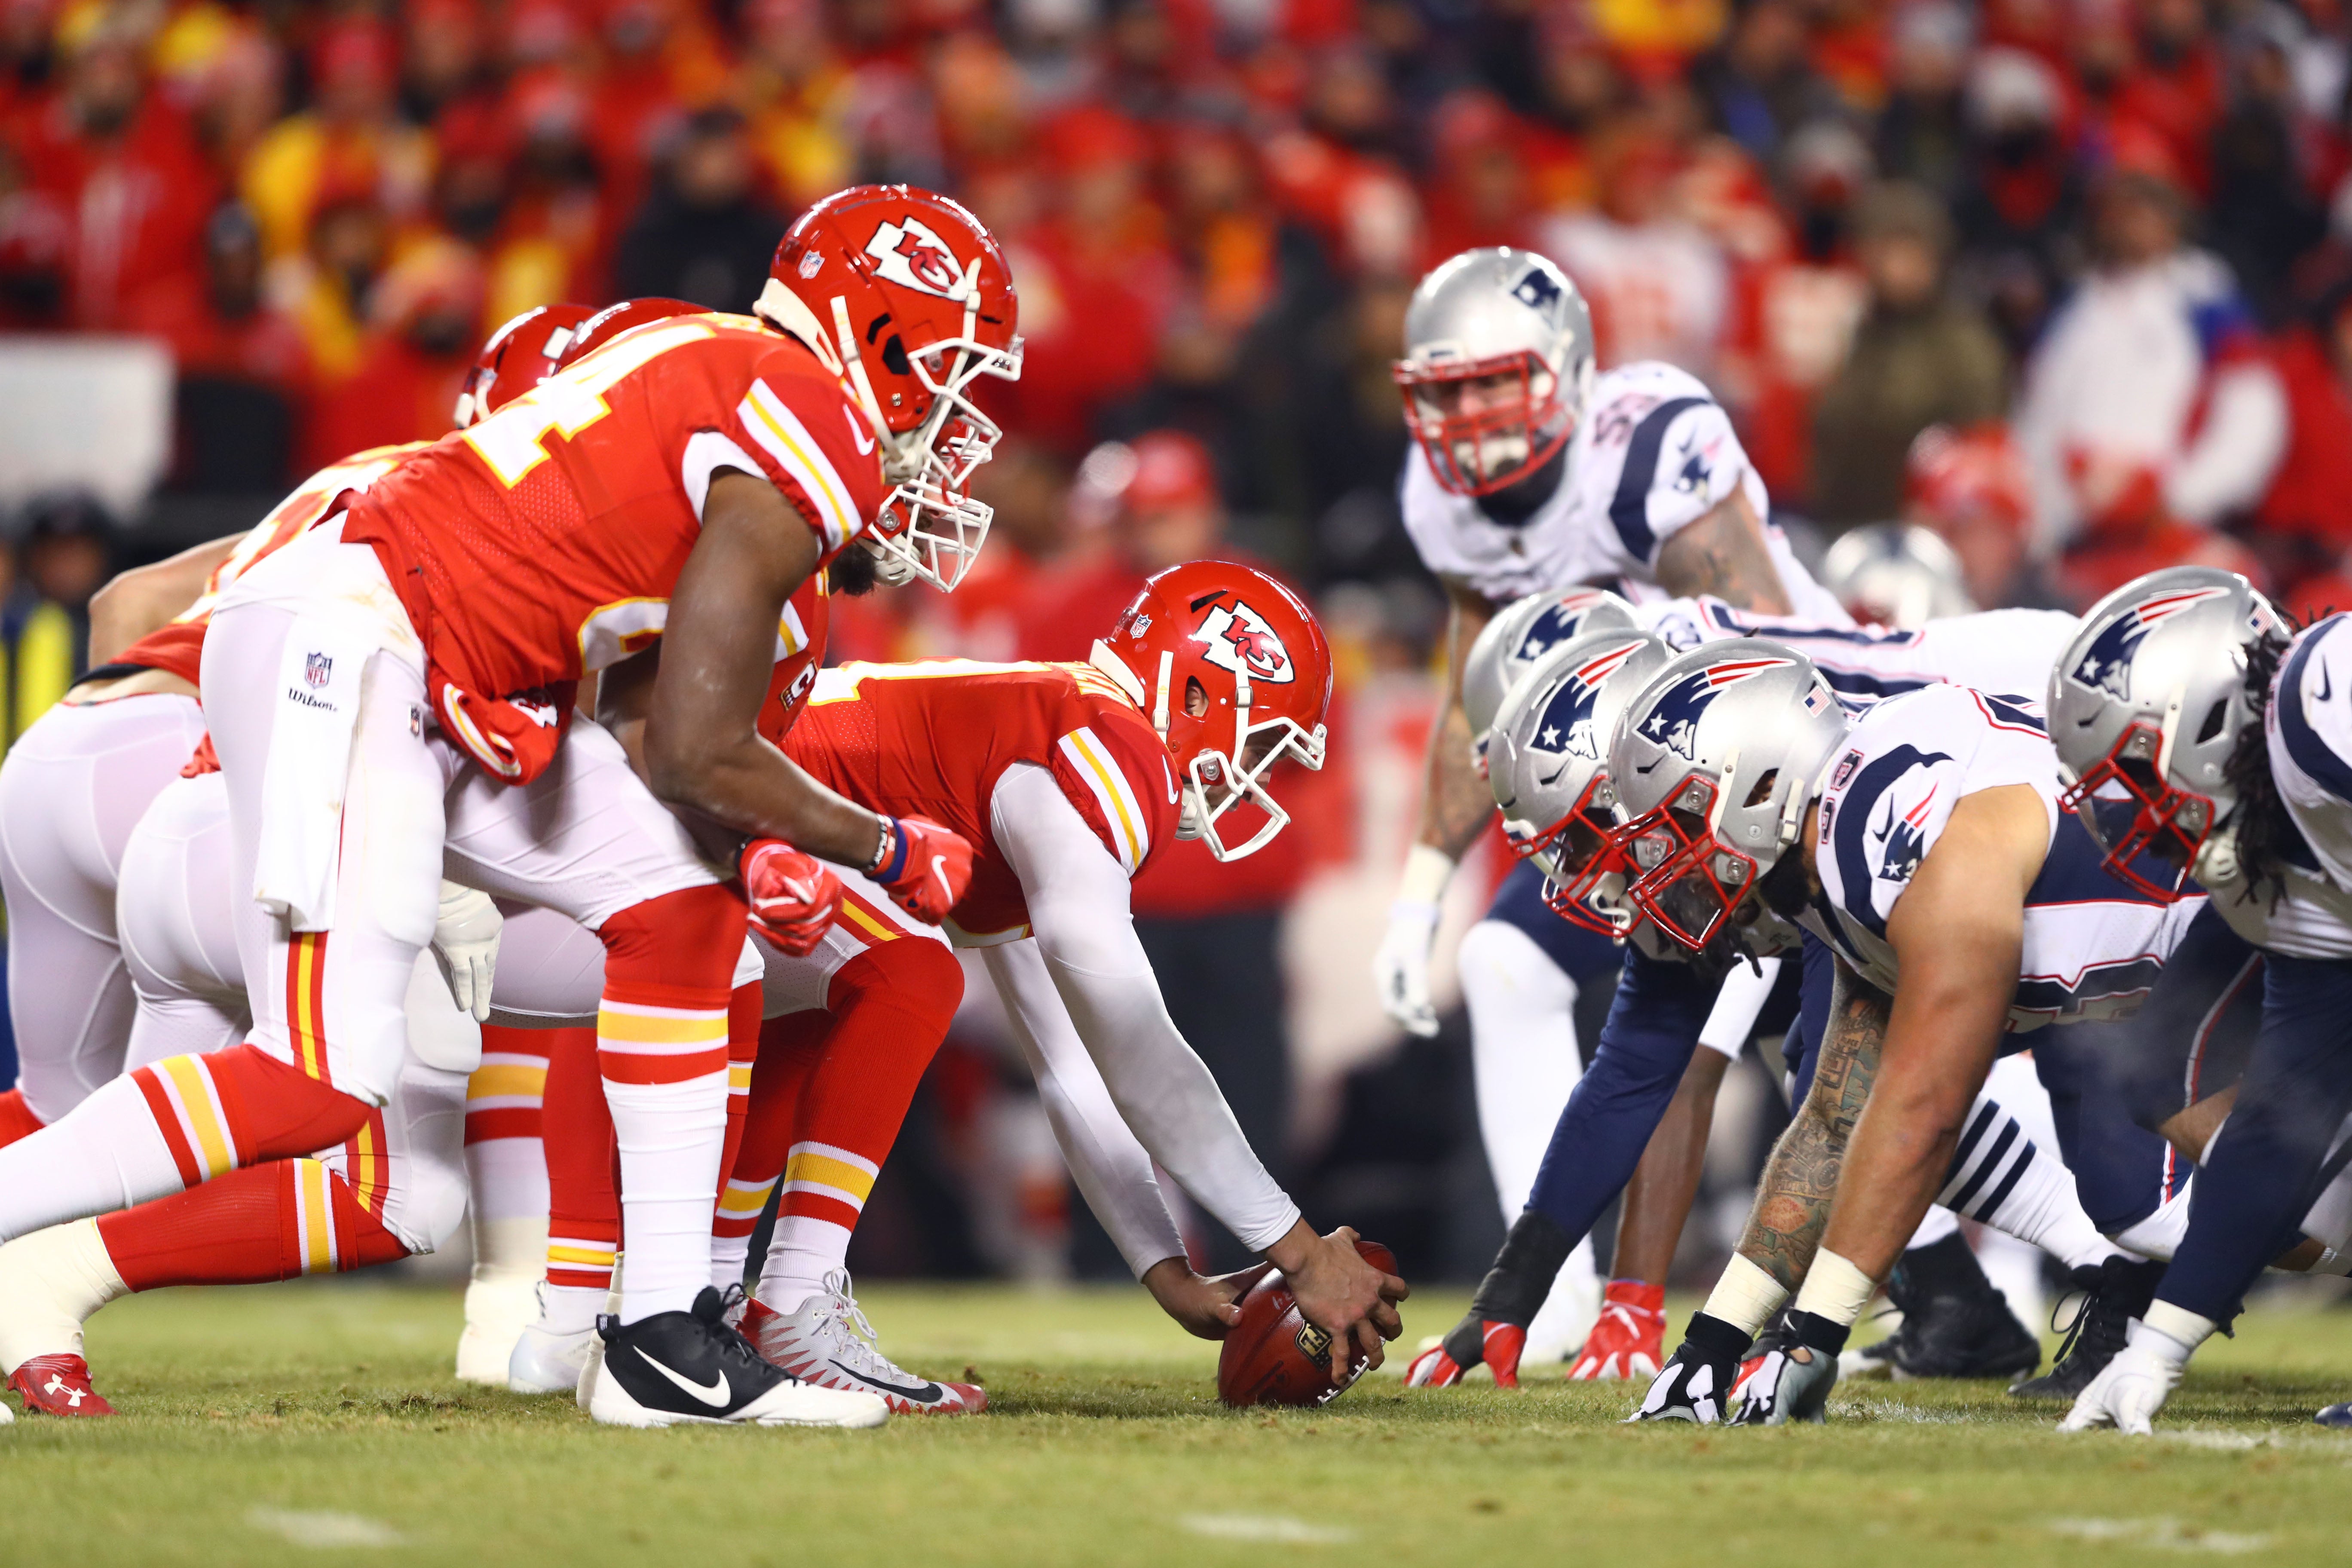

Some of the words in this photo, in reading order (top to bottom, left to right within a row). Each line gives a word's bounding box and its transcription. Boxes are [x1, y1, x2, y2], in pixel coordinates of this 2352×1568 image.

[307, 666, 326, 684] NFL
[791, 662, 815, 698] C
[289, 687, 333, 710] Wilson
